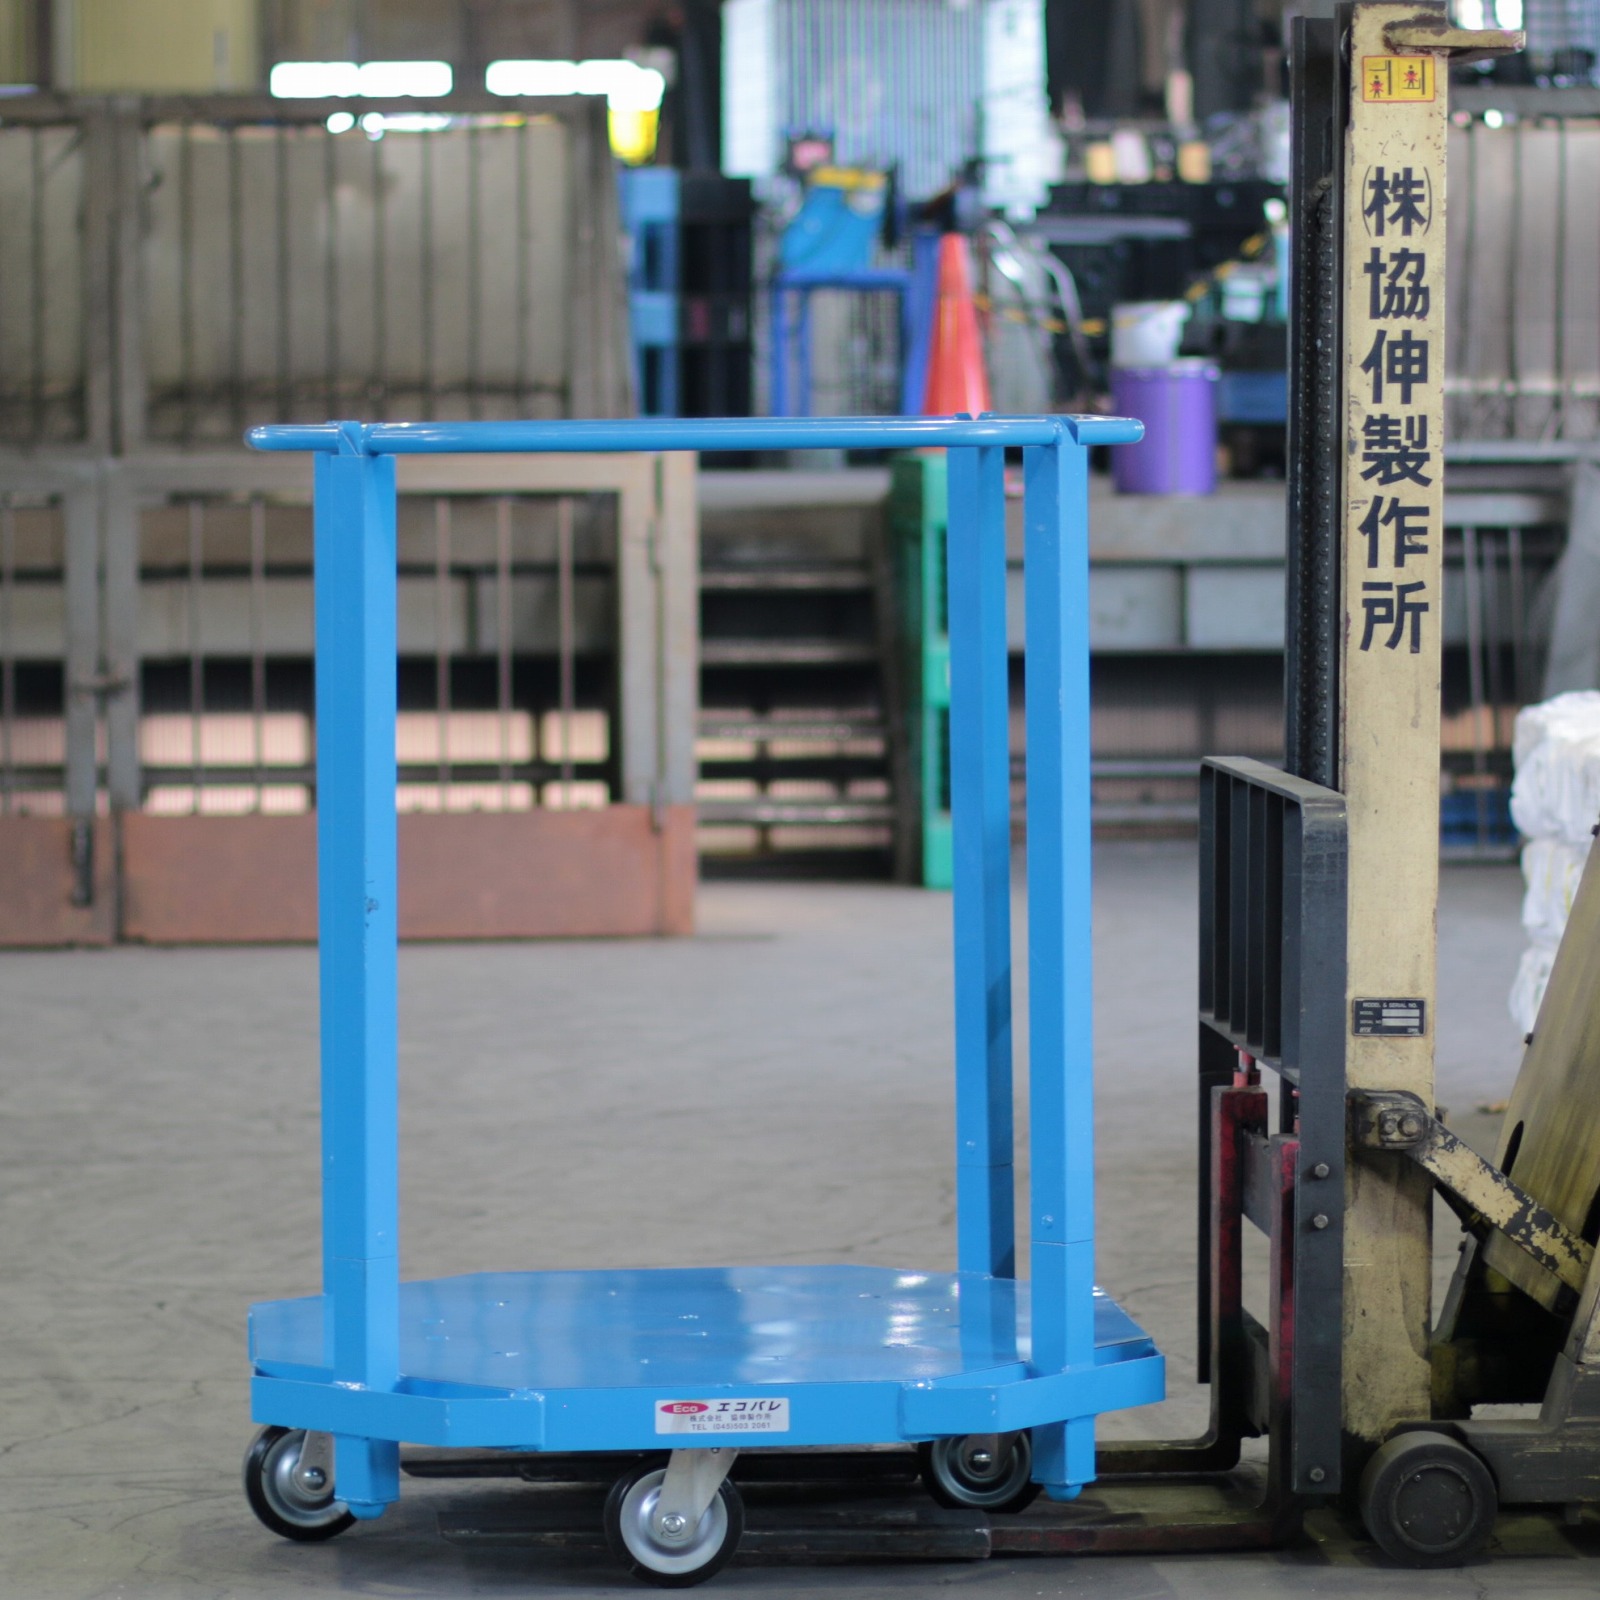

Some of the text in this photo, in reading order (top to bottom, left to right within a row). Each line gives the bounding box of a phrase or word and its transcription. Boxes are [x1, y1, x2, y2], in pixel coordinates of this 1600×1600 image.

[672, 1404, 699, 1413] Eco
[690, 1414, 722, 1422] 株式会社
